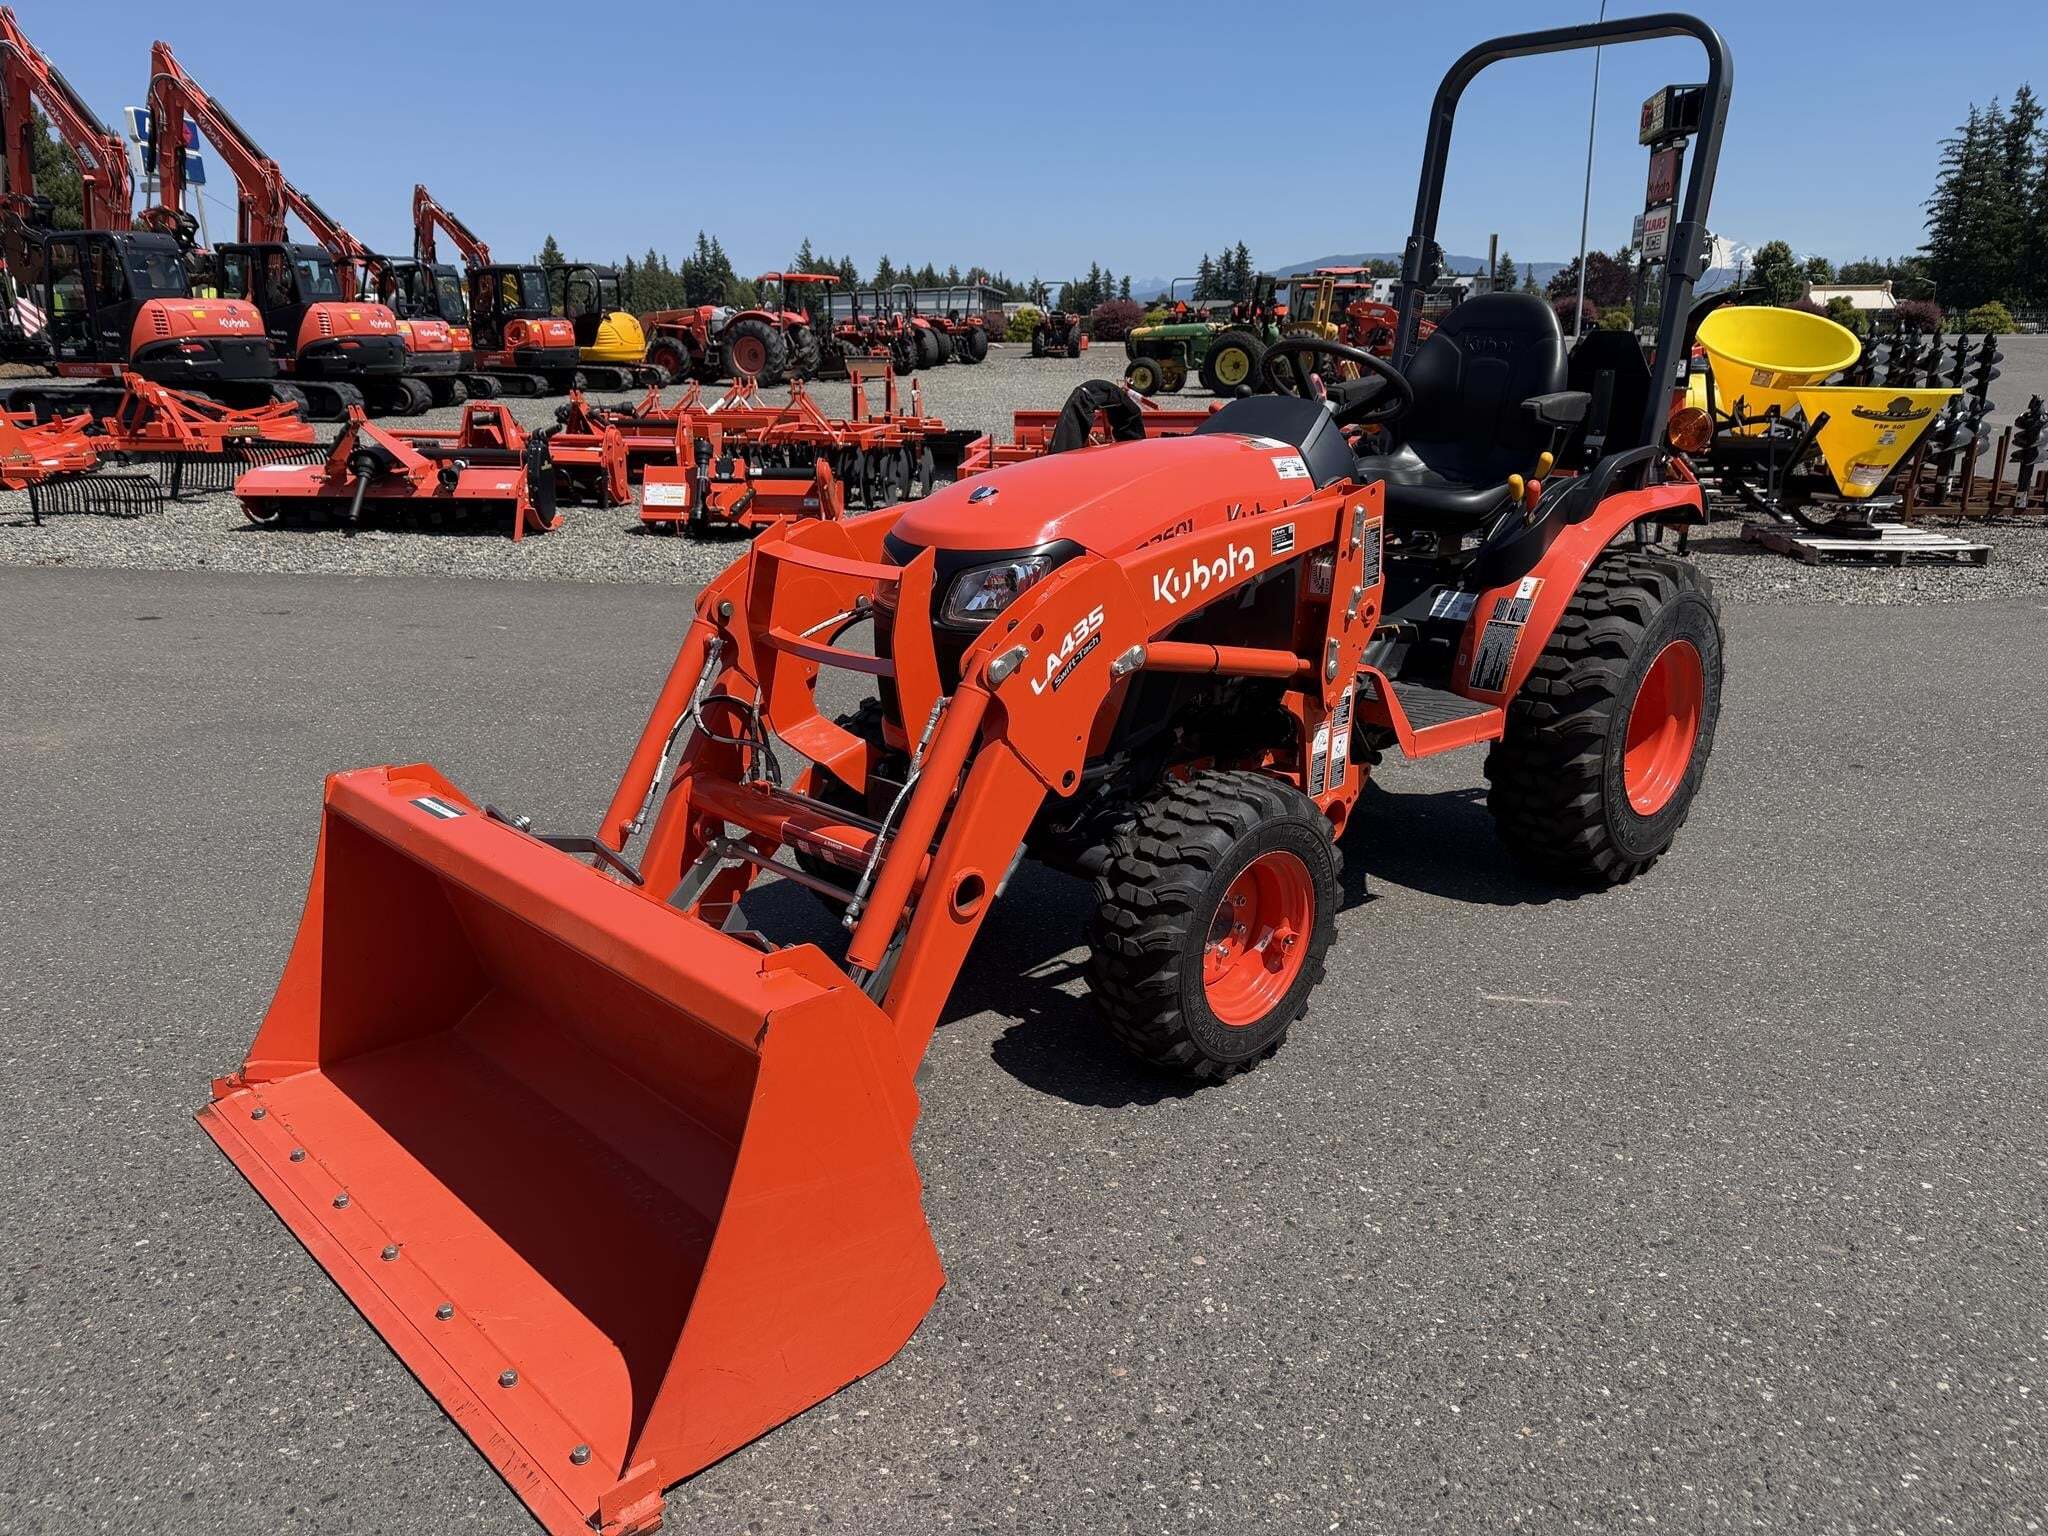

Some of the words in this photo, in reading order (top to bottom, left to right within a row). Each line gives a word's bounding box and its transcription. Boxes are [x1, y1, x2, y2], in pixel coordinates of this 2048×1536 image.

[1645, 215, 1668, 232] CLAAS
[219, 318, 250, 329] Kubota
[370, 319, 392, 329] Kubota
[1153, 543, 1256, 604] Kubota
[1030, 604, 1105, 696] LA435
[1053, 635, 1100, 688] Swift-Tach
